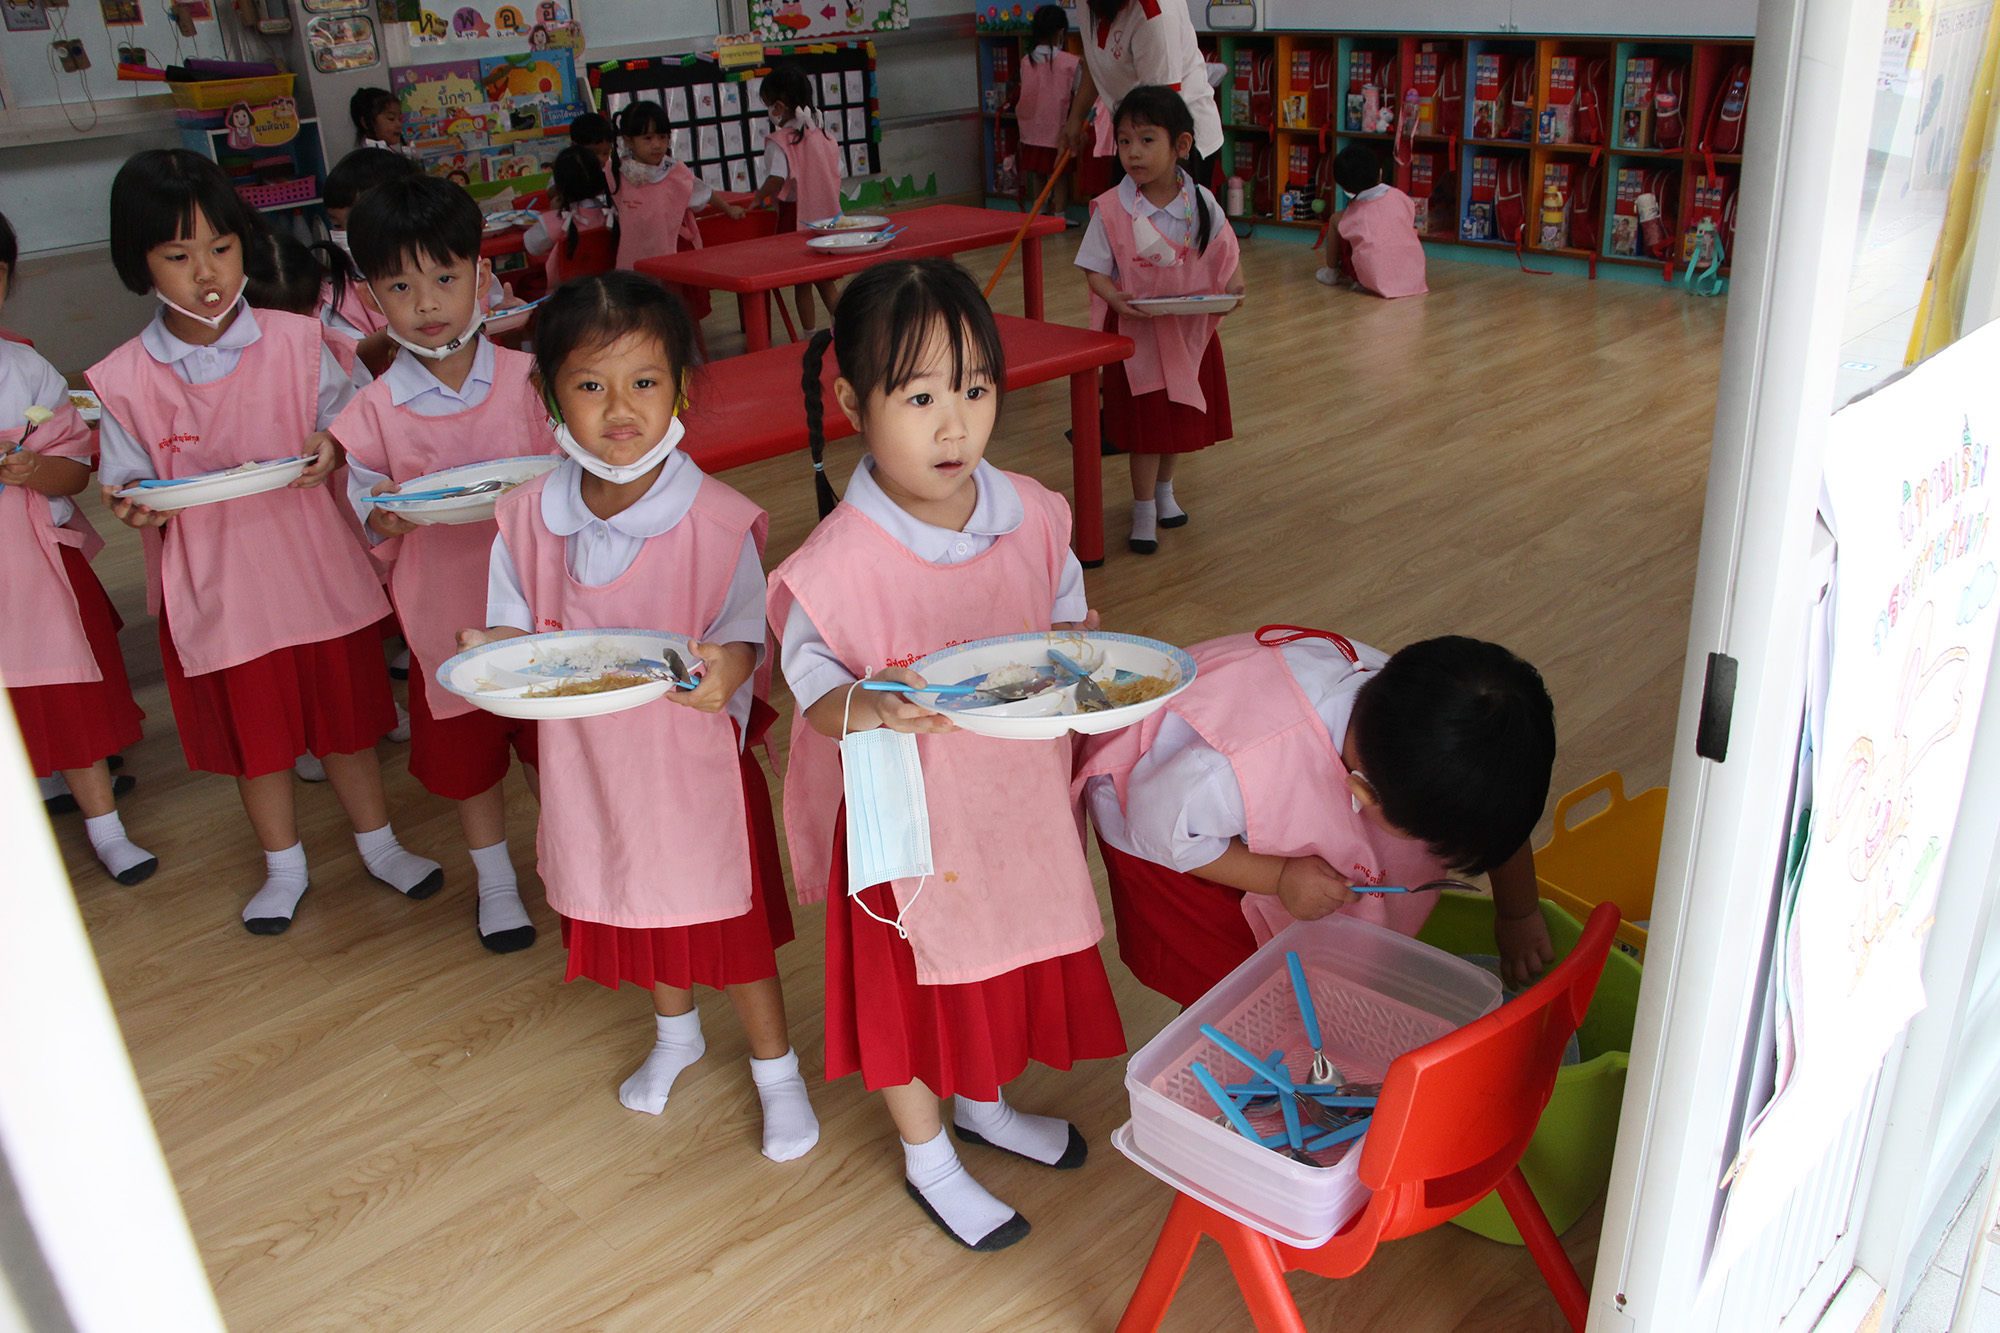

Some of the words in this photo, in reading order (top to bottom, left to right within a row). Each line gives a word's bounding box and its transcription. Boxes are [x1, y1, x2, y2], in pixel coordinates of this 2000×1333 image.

[500, 9, 517, 29] อ
[255, 120, 290, 136] มุมศิลปะ
[1898, 413, 1990, 550] นิทานเรื่อง
